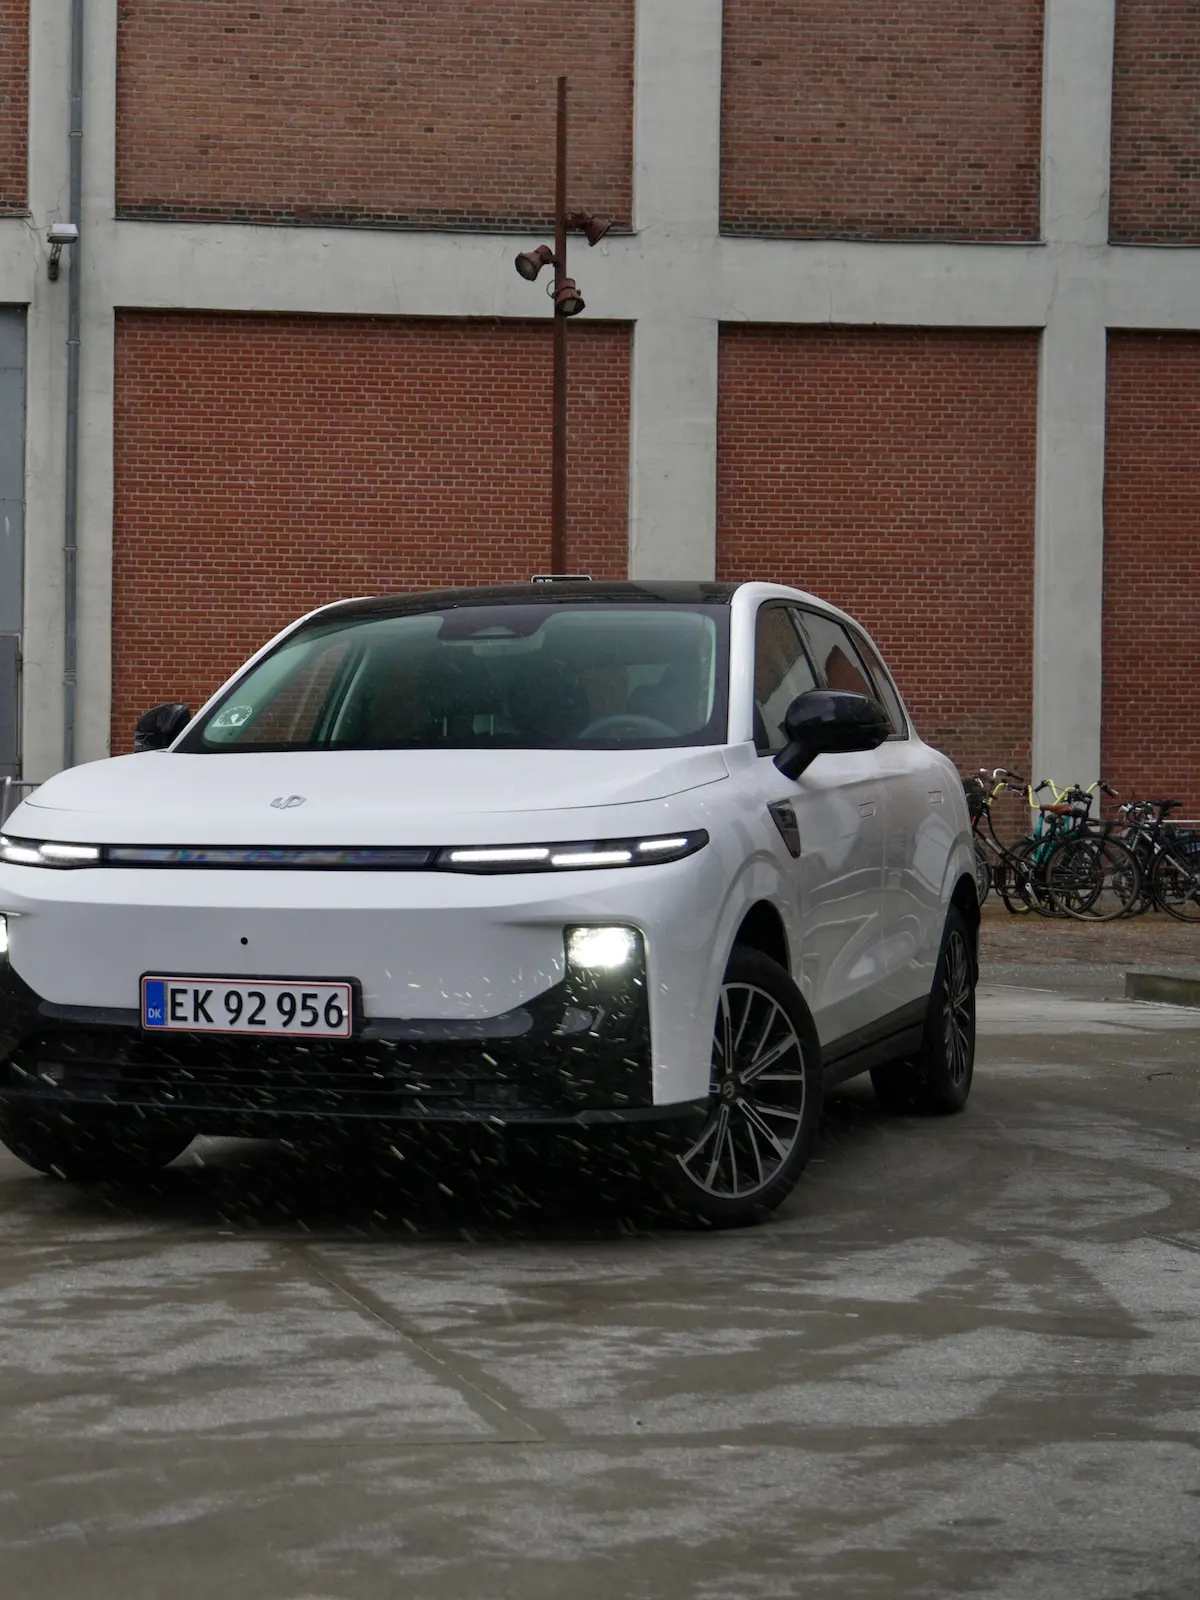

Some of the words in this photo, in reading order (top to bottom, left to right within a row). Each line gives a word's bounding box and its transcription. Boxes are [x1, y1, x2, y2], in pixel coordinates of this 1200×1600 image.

[148, 1007, 162, 1019] DK
[170, 988, 214, 1024] EK
[223, 990, 266, 1026] 92
[276, 992, 345, 1028] 956
